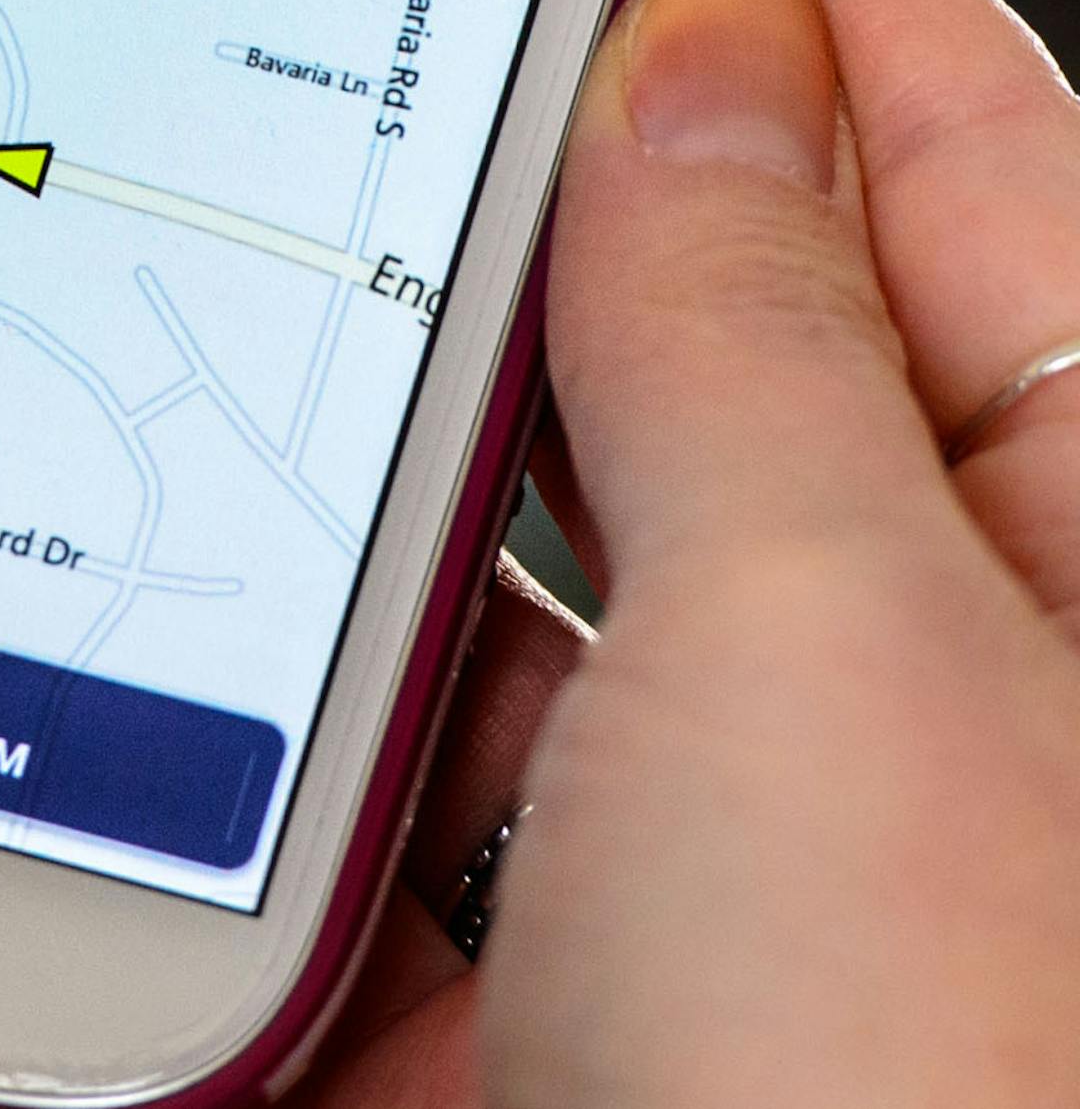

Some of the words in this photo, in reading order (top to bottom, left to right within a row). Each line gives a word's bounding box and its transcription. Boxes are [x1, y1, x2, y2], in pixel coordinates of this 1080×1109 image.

[245, 46, 332, 88] Bavaria
[340, 71, 369, 96] Ln
[383, 64, 420, 111] Rd
[375, 117, 406, 141] S
[41, 535, 86, 570] Dr
